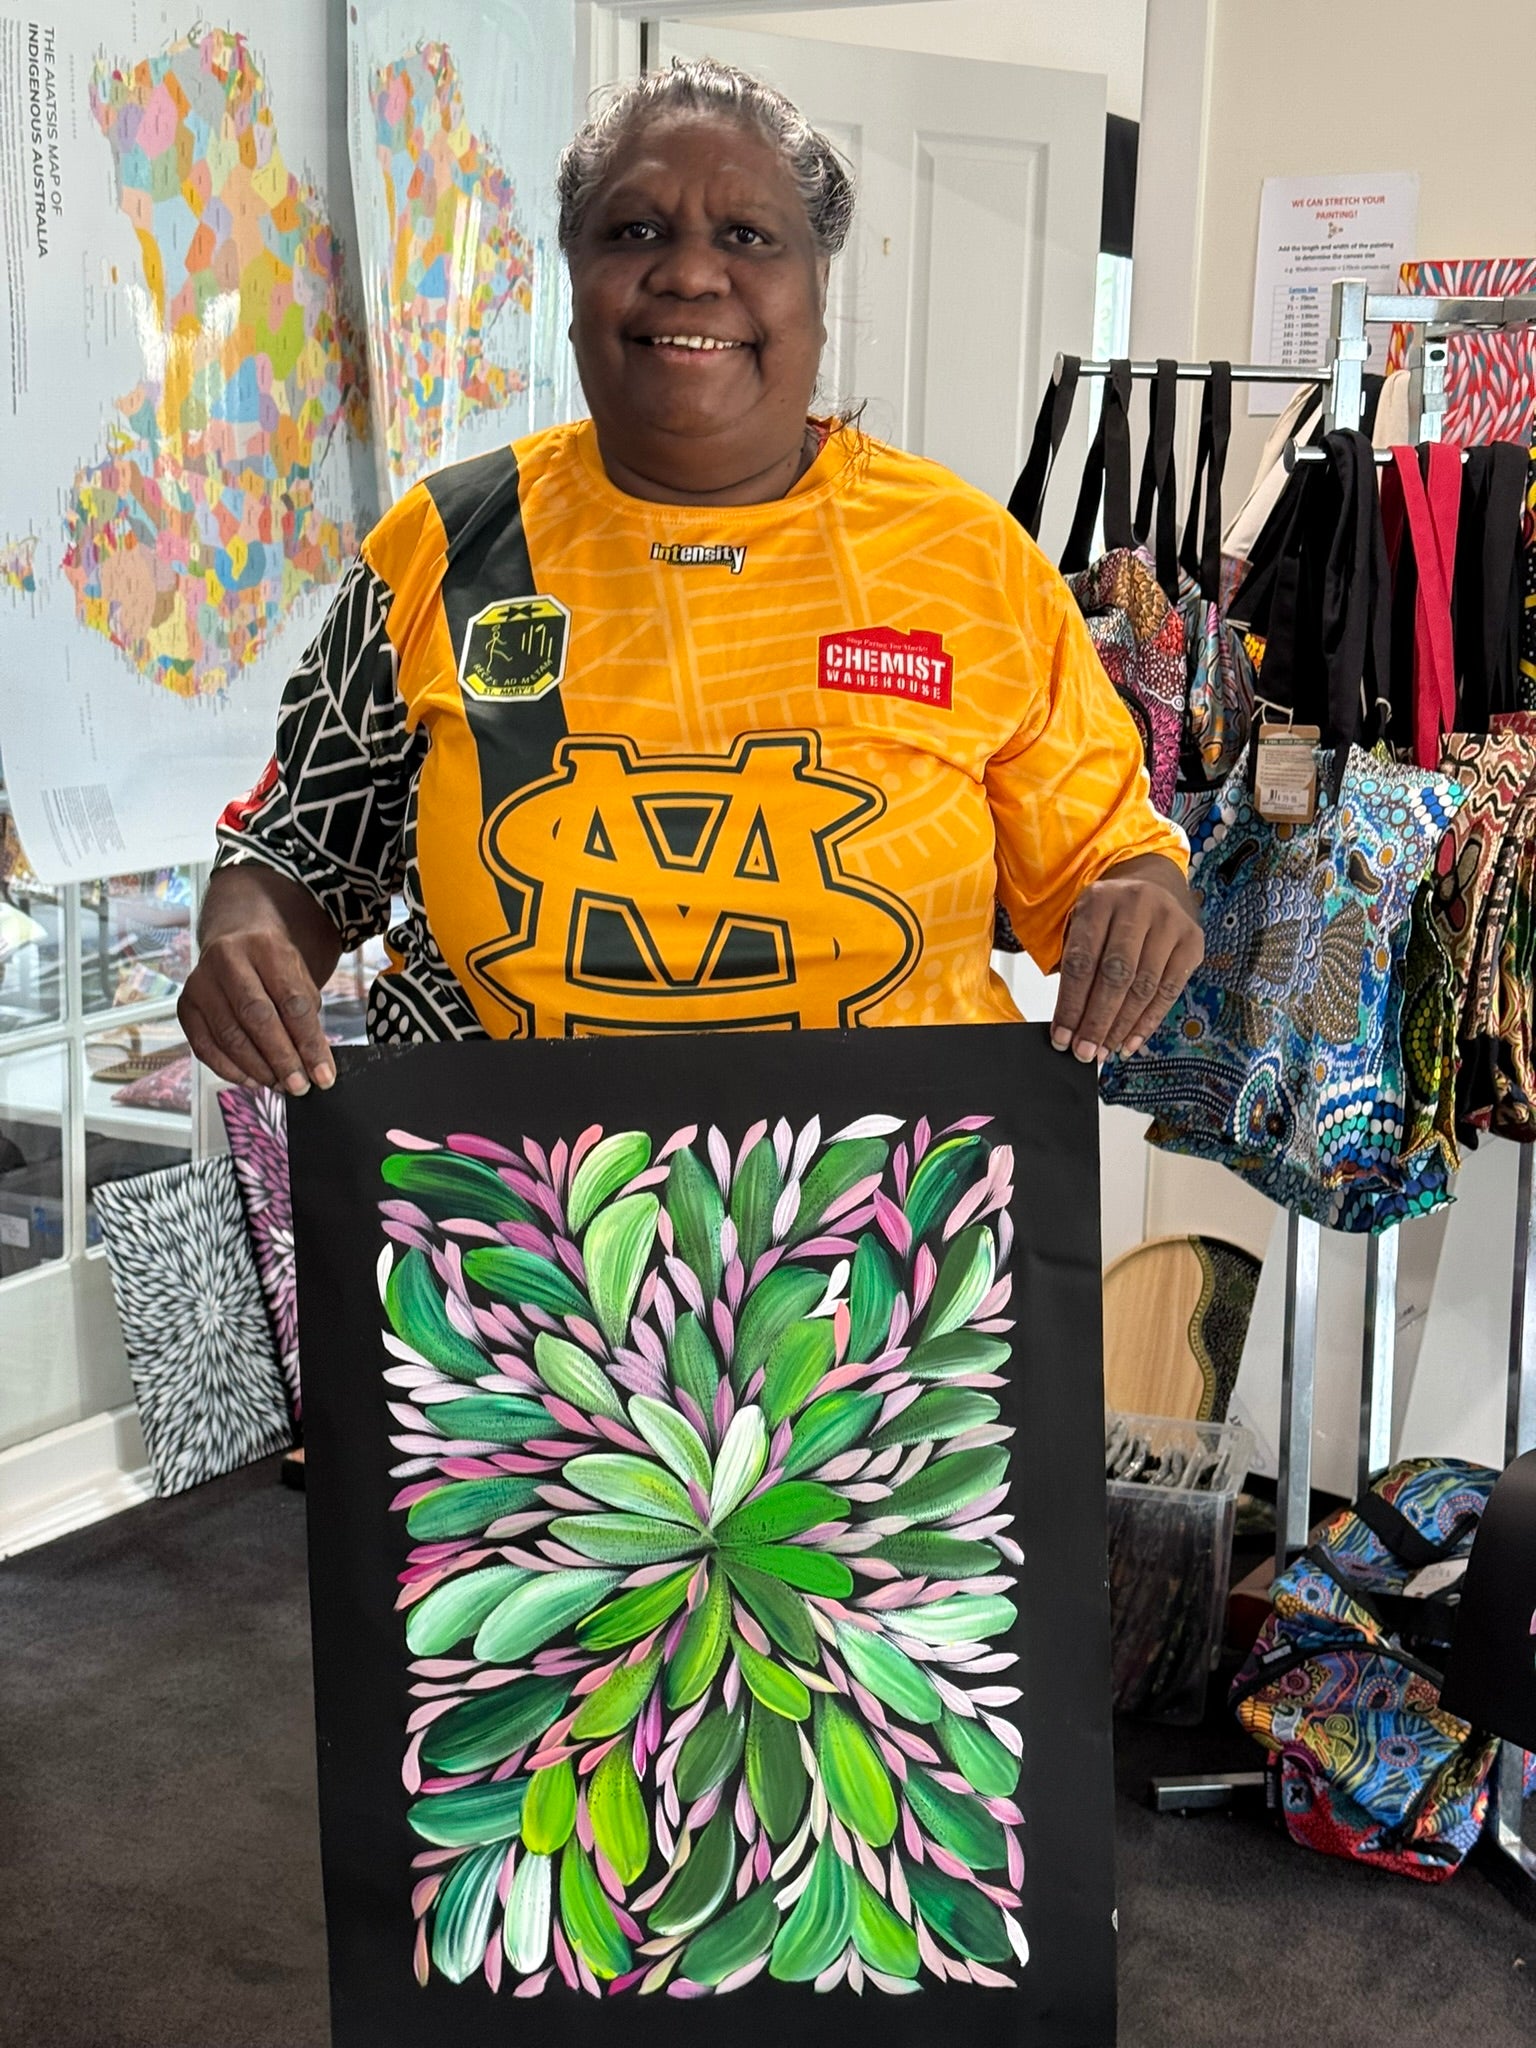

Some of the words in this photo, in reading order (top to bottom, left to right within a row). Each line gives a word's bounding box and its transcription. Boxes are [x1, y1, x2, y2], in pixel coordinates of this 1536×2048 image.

[44, 26, 55, 64] THE
[28, 22, 42, 144] INDIGENOUS
[45, 67, 58, 139] AIATSIS
[48, 144, 61, 186] MAP
[32, 148, 48, 259] AUSTRALIA
[51, 190, 63, 216] OF
[1292, 199, 1305, 208] WE
[1306, 198, 1323, 207] CAN
[1325, 196, 1360, 206] STRETCH
[1362, 195, 1386, 205] YOUR
[1316, 210, 1358, 220] PAINTING!
[1302, 244, 1320, 253] length
[650, 542, 747, 575] intensity
[826, 643, 946, 684] CHEMIST
[826, 669, 941, 700] WAREHOUSE
